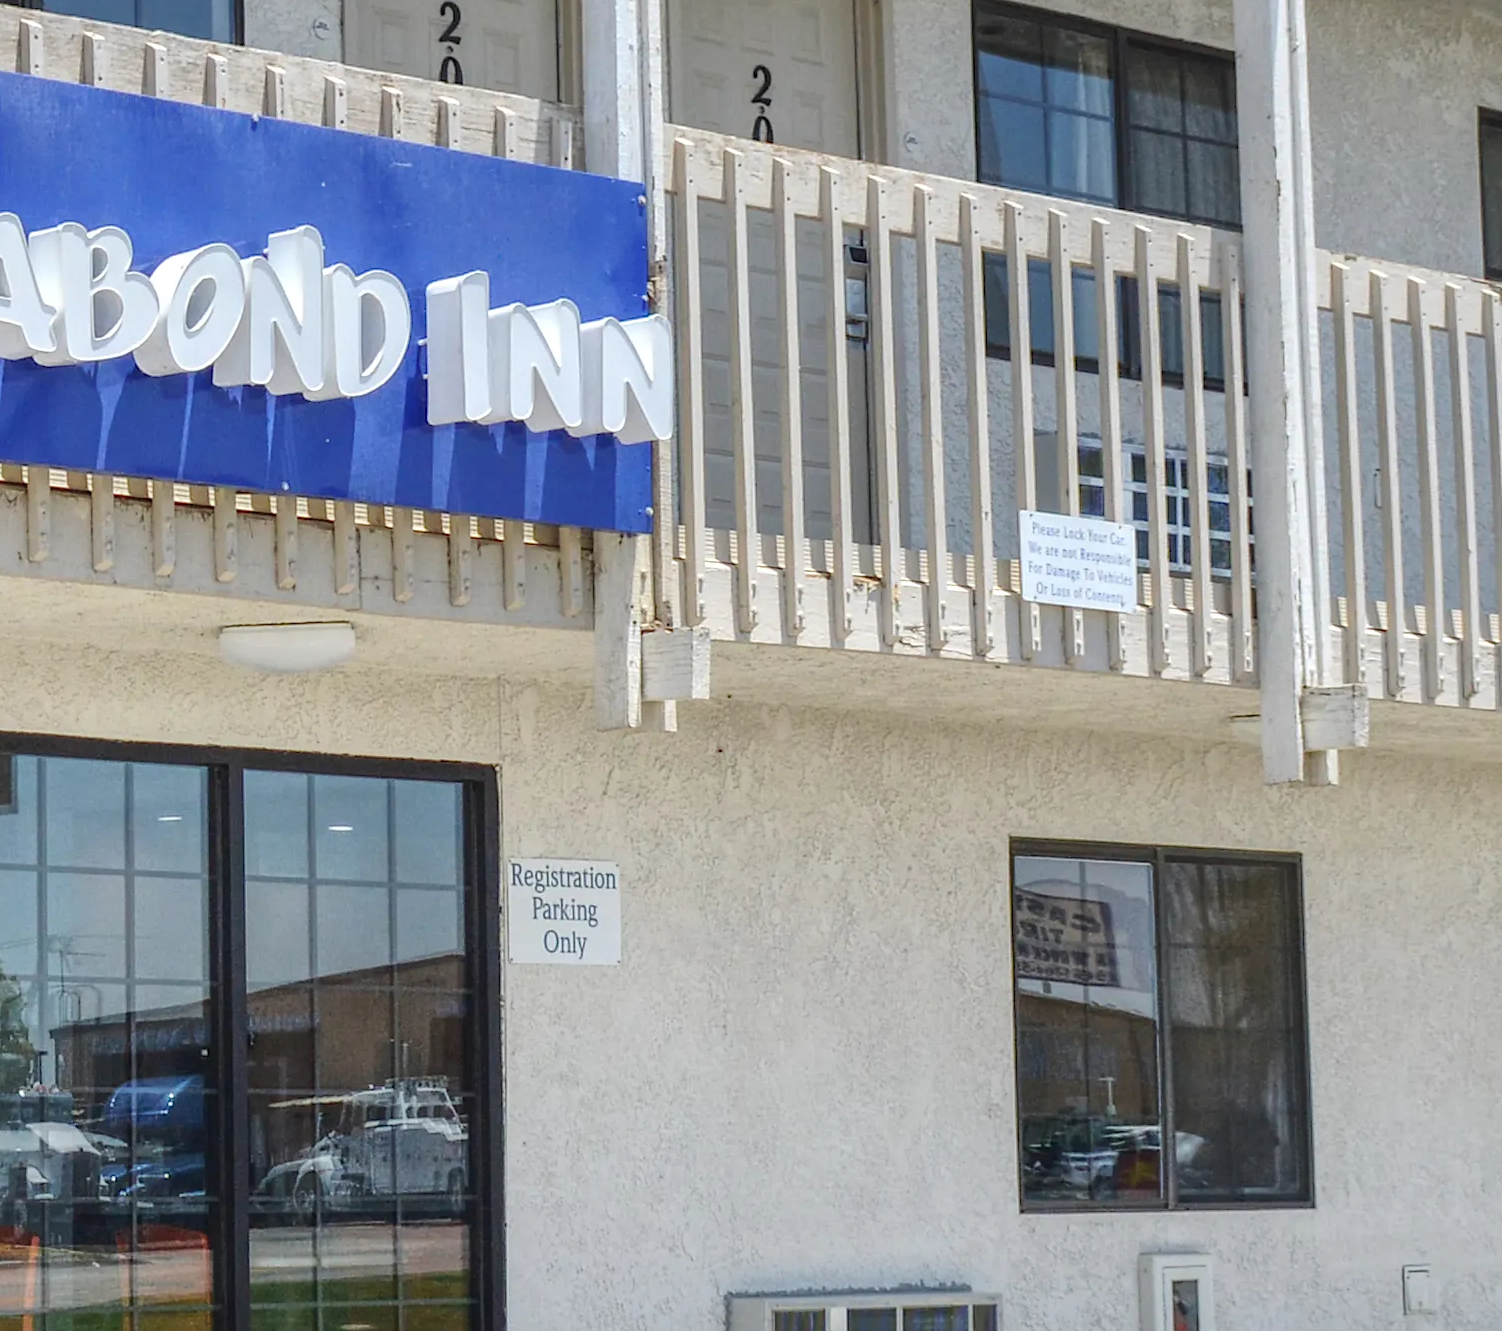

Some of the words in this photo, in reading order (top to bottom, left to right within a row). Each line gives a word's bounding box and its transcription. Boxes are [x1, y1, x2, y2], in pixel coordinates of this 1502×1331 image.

[425, 270, 674, 444] INN
[1032, 521, 1060, 537] Please
[1063, 525, 1085, 541] Lock
[1087, 528, 1108, 543] Your
[1028, 540, 1042, 555] We
[1045, 545, 1059, 557] are
[1062, 547, 1078, 560] not
[1079, 547, 1132, 566] Responsible
[1028, 560, 1043, 574] For
[1046, 563, 1080, 583] Damage
[1083, 567, 1095, 581] To
[1096, 568, 1134, 587] Vehicles
[1036, 581, 1048, 595] Or
[1051, 583, 1071, 598] Loss
[1073, 587, 1083, 600] of
[511, 863, 617, 894] Registration
[532, 896, 599, 927] Parking
[543, 930, 588, 960] Only
